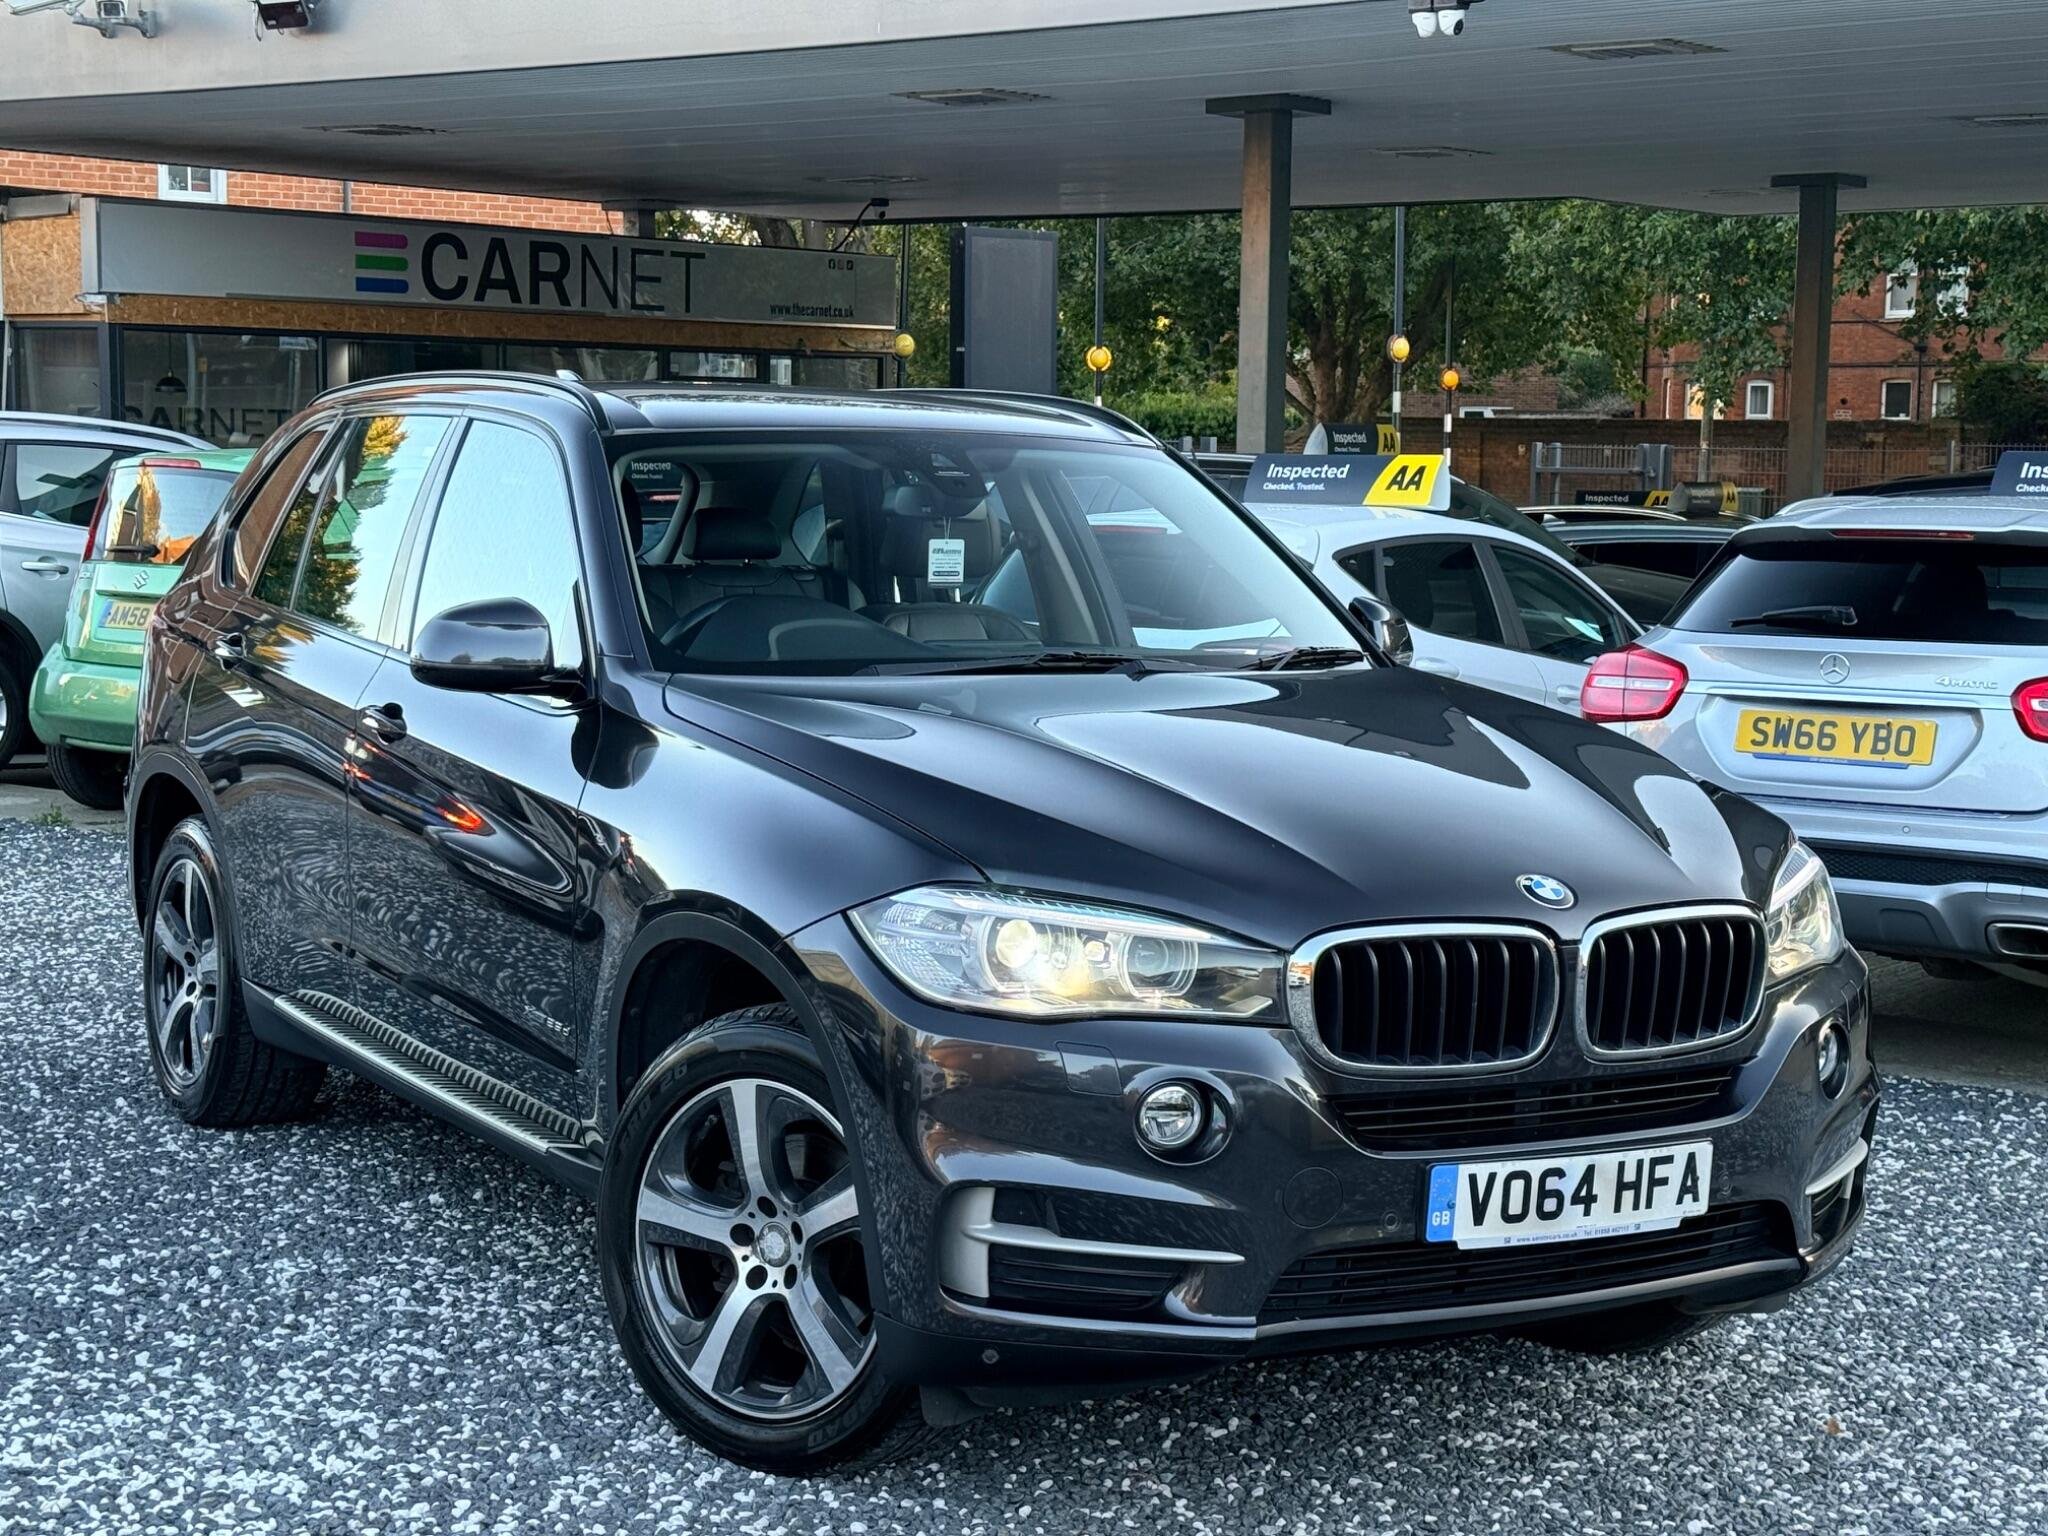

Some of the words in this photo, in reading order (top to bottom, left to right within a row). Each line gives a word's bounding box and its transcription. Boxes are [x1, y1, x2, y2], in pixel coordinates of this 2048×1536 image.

[421, 231, 706, 313] CARNET
[769, 302, 855, 318] www.thecarnet.co.uk
[1332, 430, 1367, 445] Inspected
[1383, 432, 1395, 452] AA
[1266, 463, 1350, 481] Inspected
[1385, 465, 1427, 491] AA
[1585, 494, 1629, 503] Inspected
[109, 606, 150, 626] AM58
[1935, 674, 1999, 690] 4MATIC
[1750, 716, 1838, 751] SW66
[1850, 721, 1917, 757] YBO
[1468, 1163, 1599, 1227] VO64
[1613, 1151, 1701, 1214] HFA
[1431, 1211, 1450, 1226] GB
